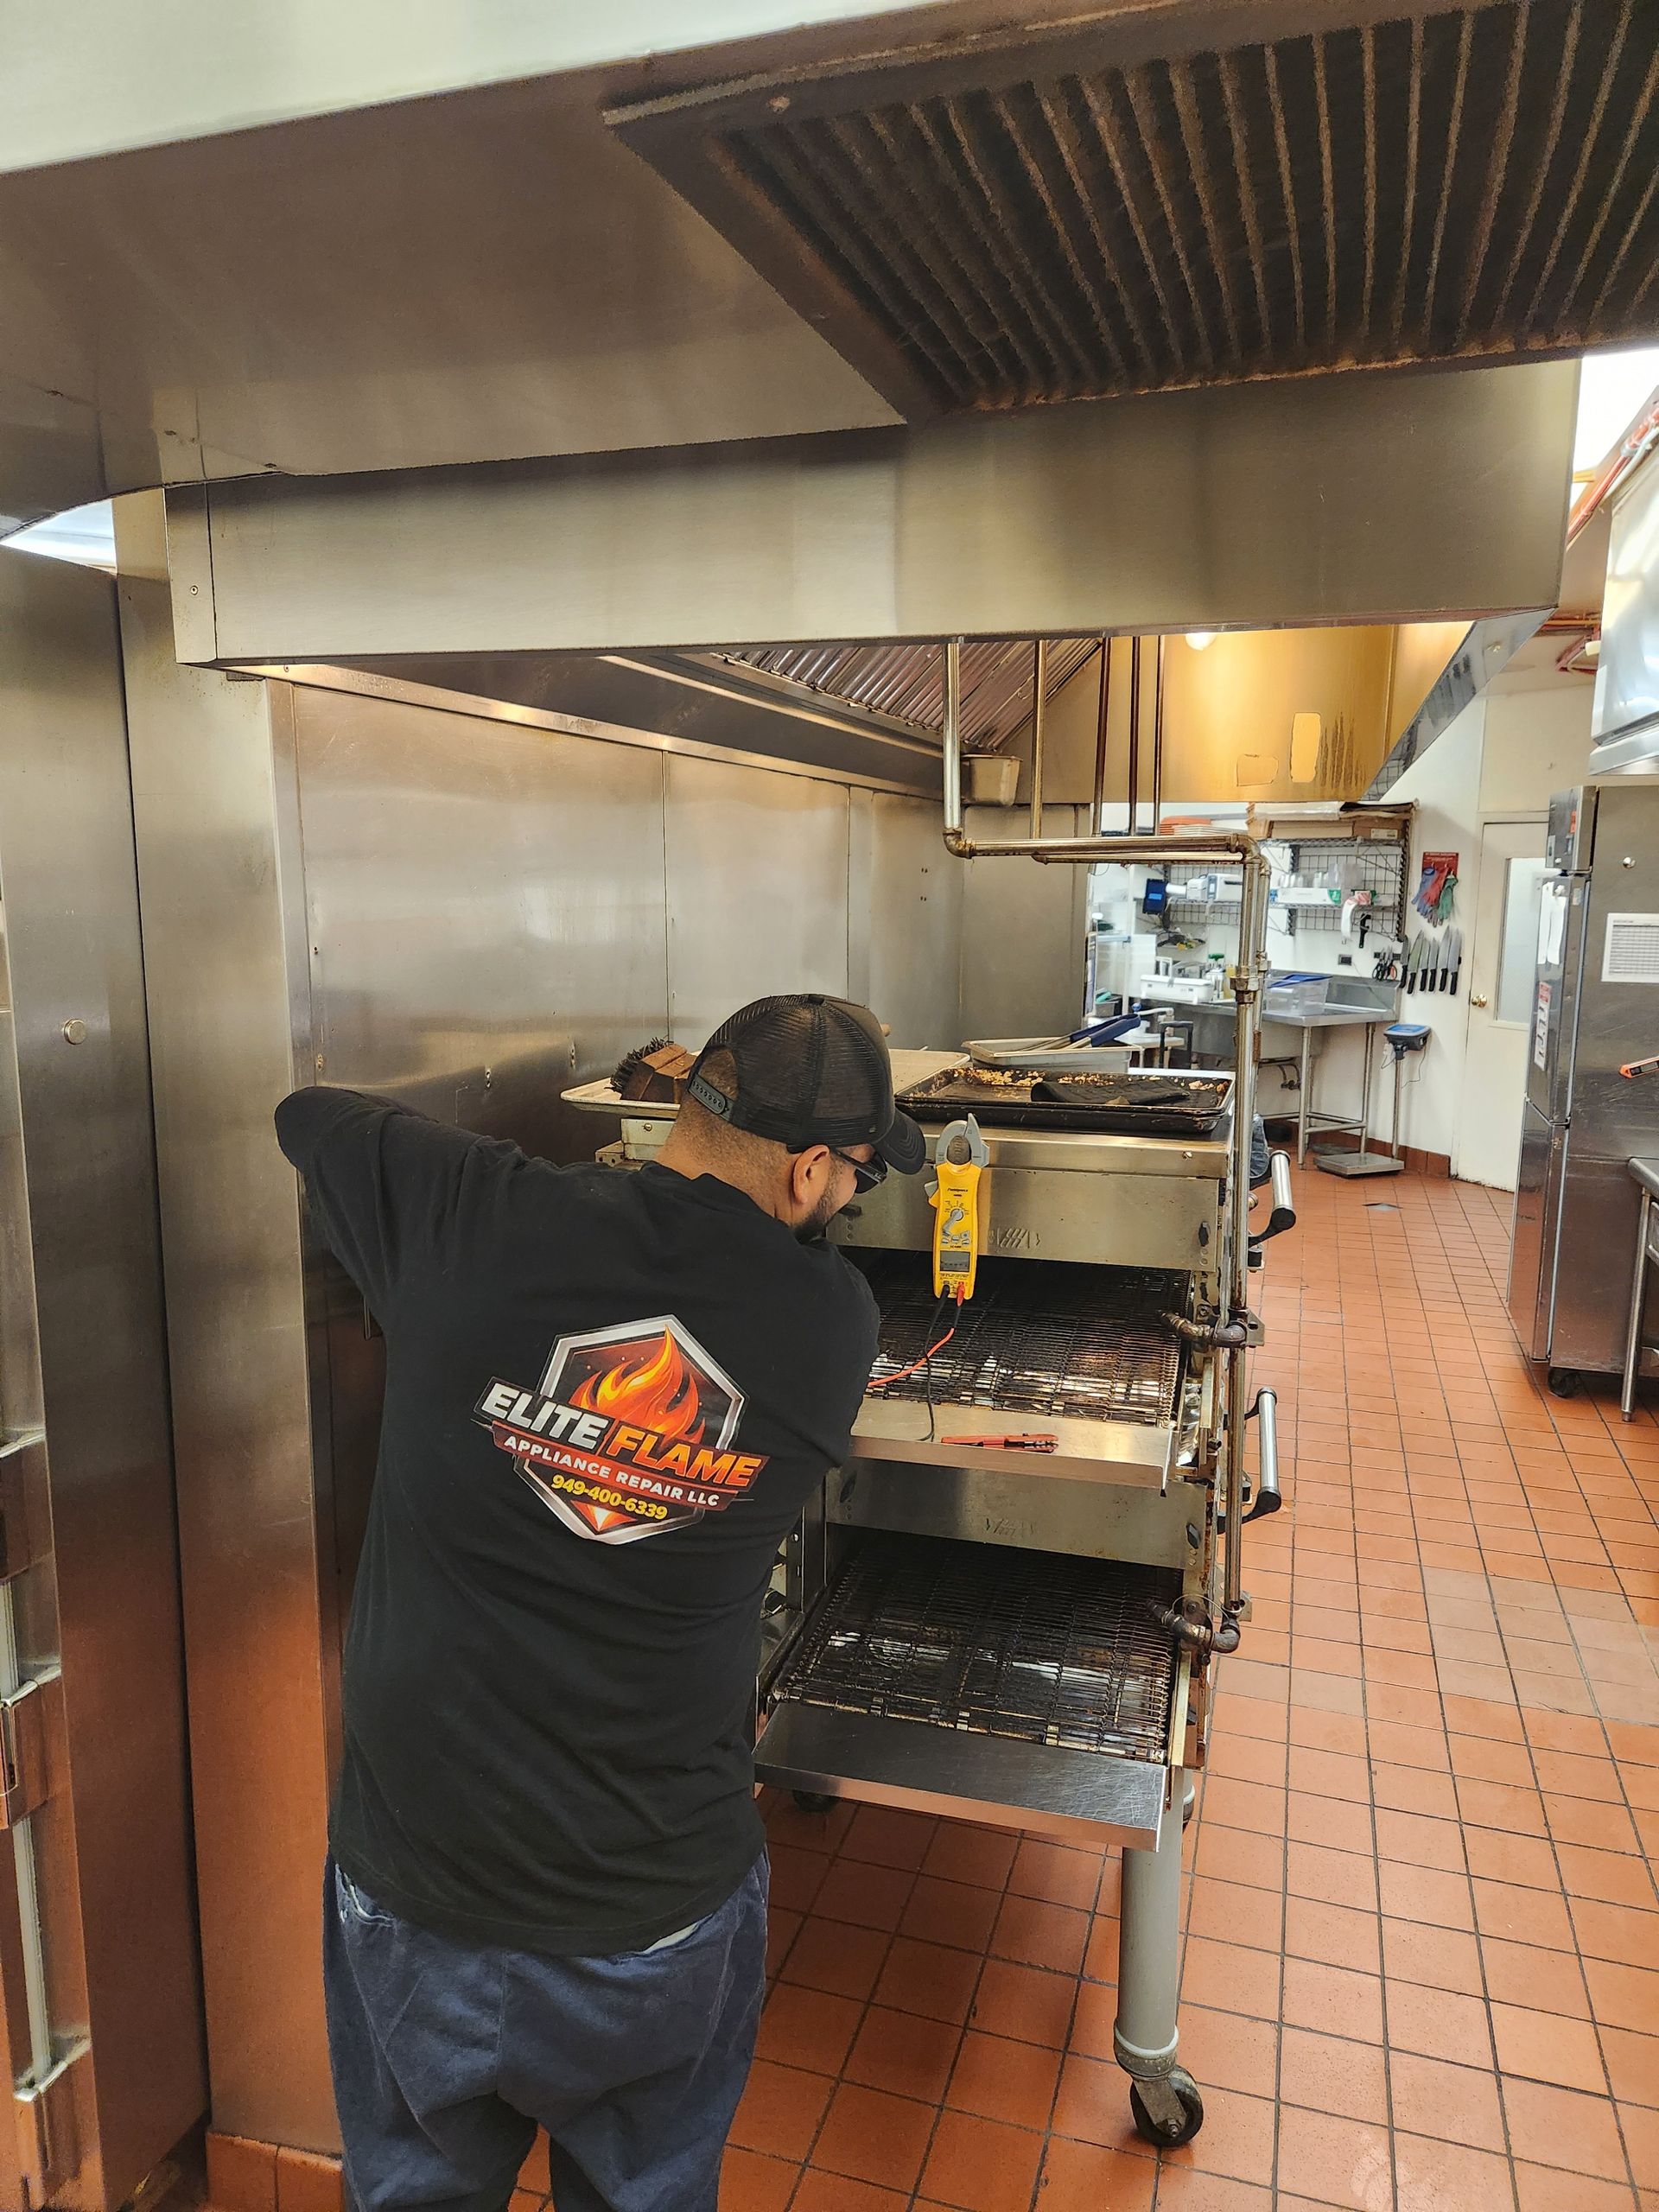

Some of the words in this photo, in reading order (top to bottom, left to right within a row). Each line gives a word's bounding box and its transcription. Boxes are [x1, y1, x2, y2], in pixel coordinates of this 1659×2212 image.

[480, 1382, 610, 1450] ELITE
[606, 1425, 761, 1487] FLAME
[504, 1435, 611, 1478] APPLIANCE
[615, 1471, 683, 1501] REPAIR
[687, 1491, 720, 1507] LLC
[550, 1474, 668, 1520] 949-400-6339
